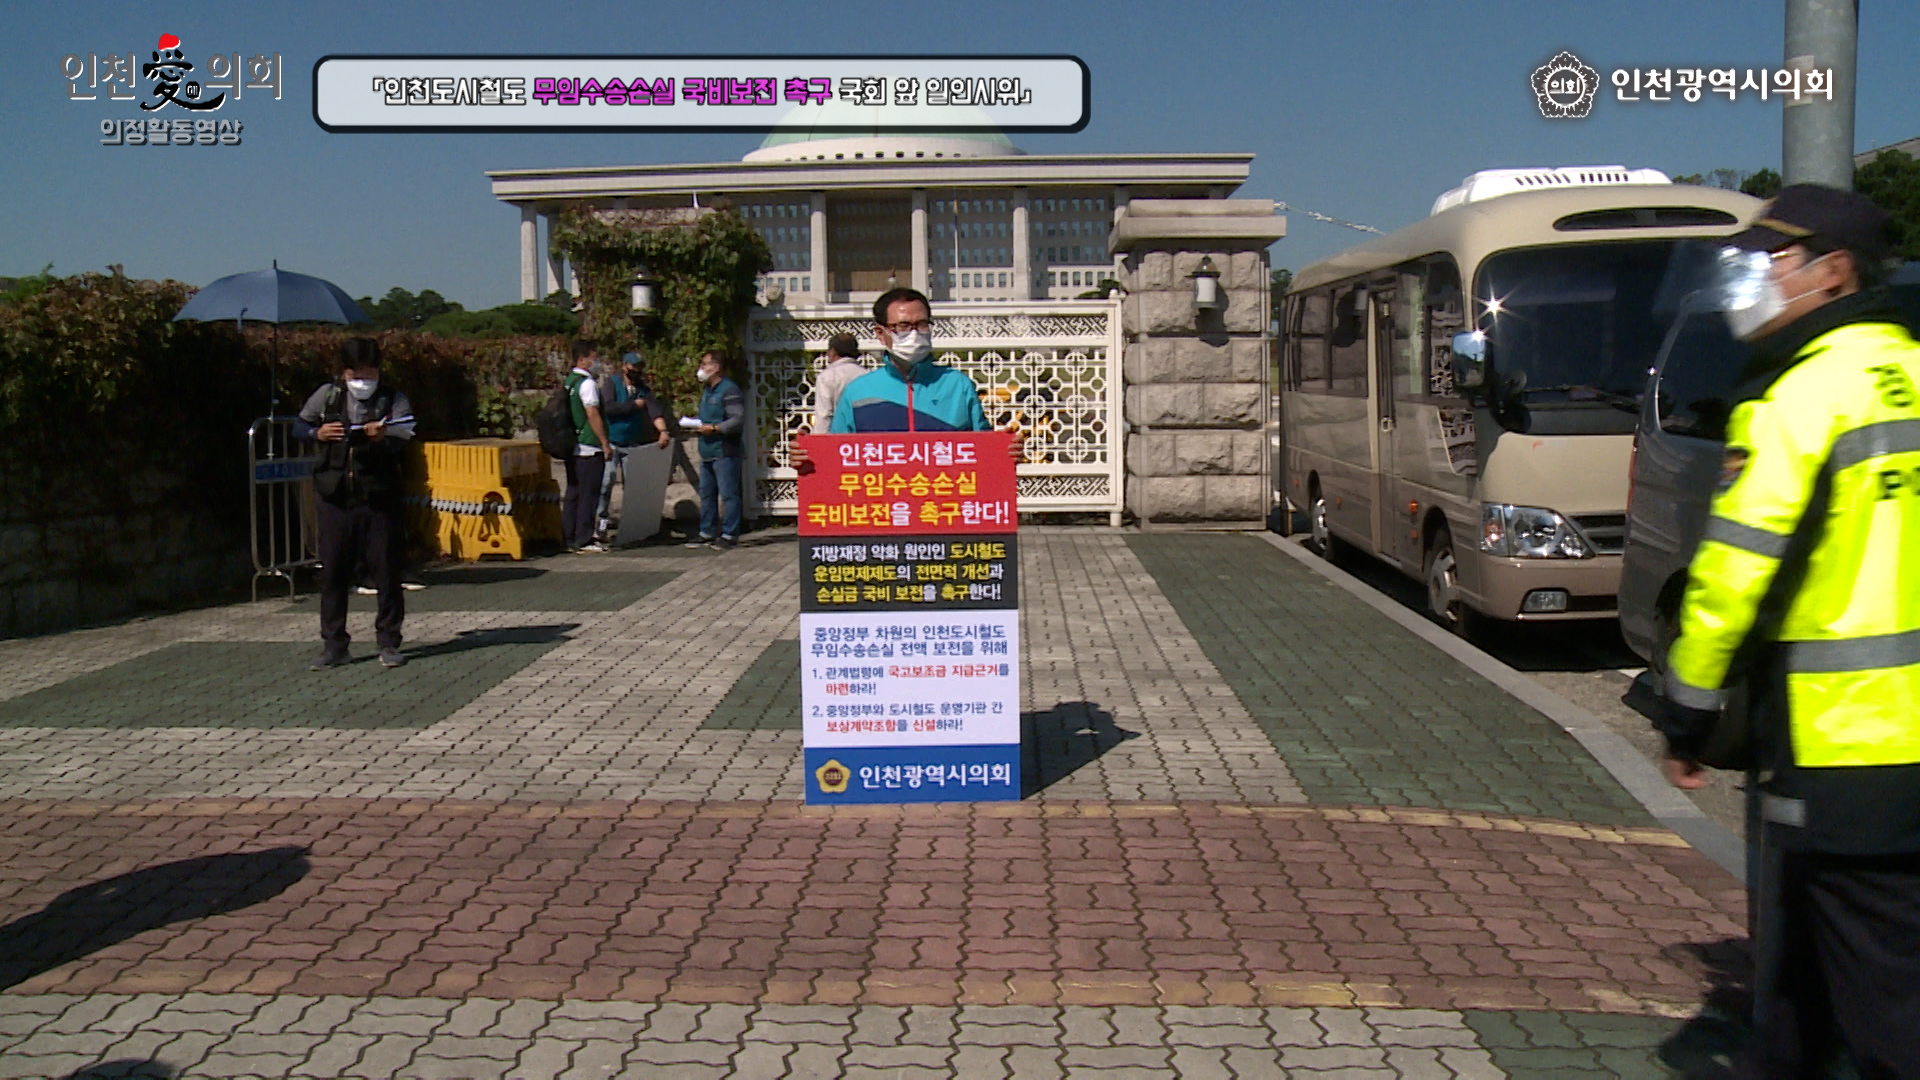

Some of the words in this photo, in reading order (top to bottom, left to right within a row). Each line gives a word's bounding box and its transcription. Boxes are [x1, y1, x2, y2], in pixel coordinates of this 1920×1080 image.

[839, 441, 977, 467] 인천도시철도
[839, 471, 977, 497] 무임수송손실
[807, 501, 911, 527] 국비보전을
[919, 501, 1009, 526] 촉구한다!
[811, 544, 867, 562] 지방재정
[871, 544, 899, 561] 악화
[903, 543, 945, 560] 원인인
[949, 542, 1006, 559] 도시철도
[813, 564, 911, 582] 운임면제제도의
[915, 563, 957, 580] 전면적
[962, 563, 1004, 580] 개선과
[816, 586, 858, 603] 손실금
[862, 585, 890, 602] 국비
[895, 584, 937, 602] 보전을
[941, 584, 1001, 601] 촉구한다!
[814, 626, 869, 642] 중앙정부
[875, 625, 917, 640] 차원의
[922, 624, 1006, 640] 인천도시철도
[810, 643, 894, 658] 무임수송손실
[900, 641, 927, 656] 전액
[932, 641, 974, 656] 보전을
[980, 640, 1008, 656] 위해
[811, 668, 823, 680] 1.
[825, 666, 884, 680] 관계법령에
[888, 664, 947, 679] 국고보조금
[951, 663, 1009, 679] 지급근거를
[826, 682, 877, 696] 마련하라!
[811, 705, 824, 717] 2.
[826, 704, 884, 717] 중앙정부와
[889, 703, 936, 716] 도시철도
[991, 701, 1003, 714] 간
[912, 718, 963, 732] 신설하라!
[859, 762, 1011, 789] 인천광역시의회
